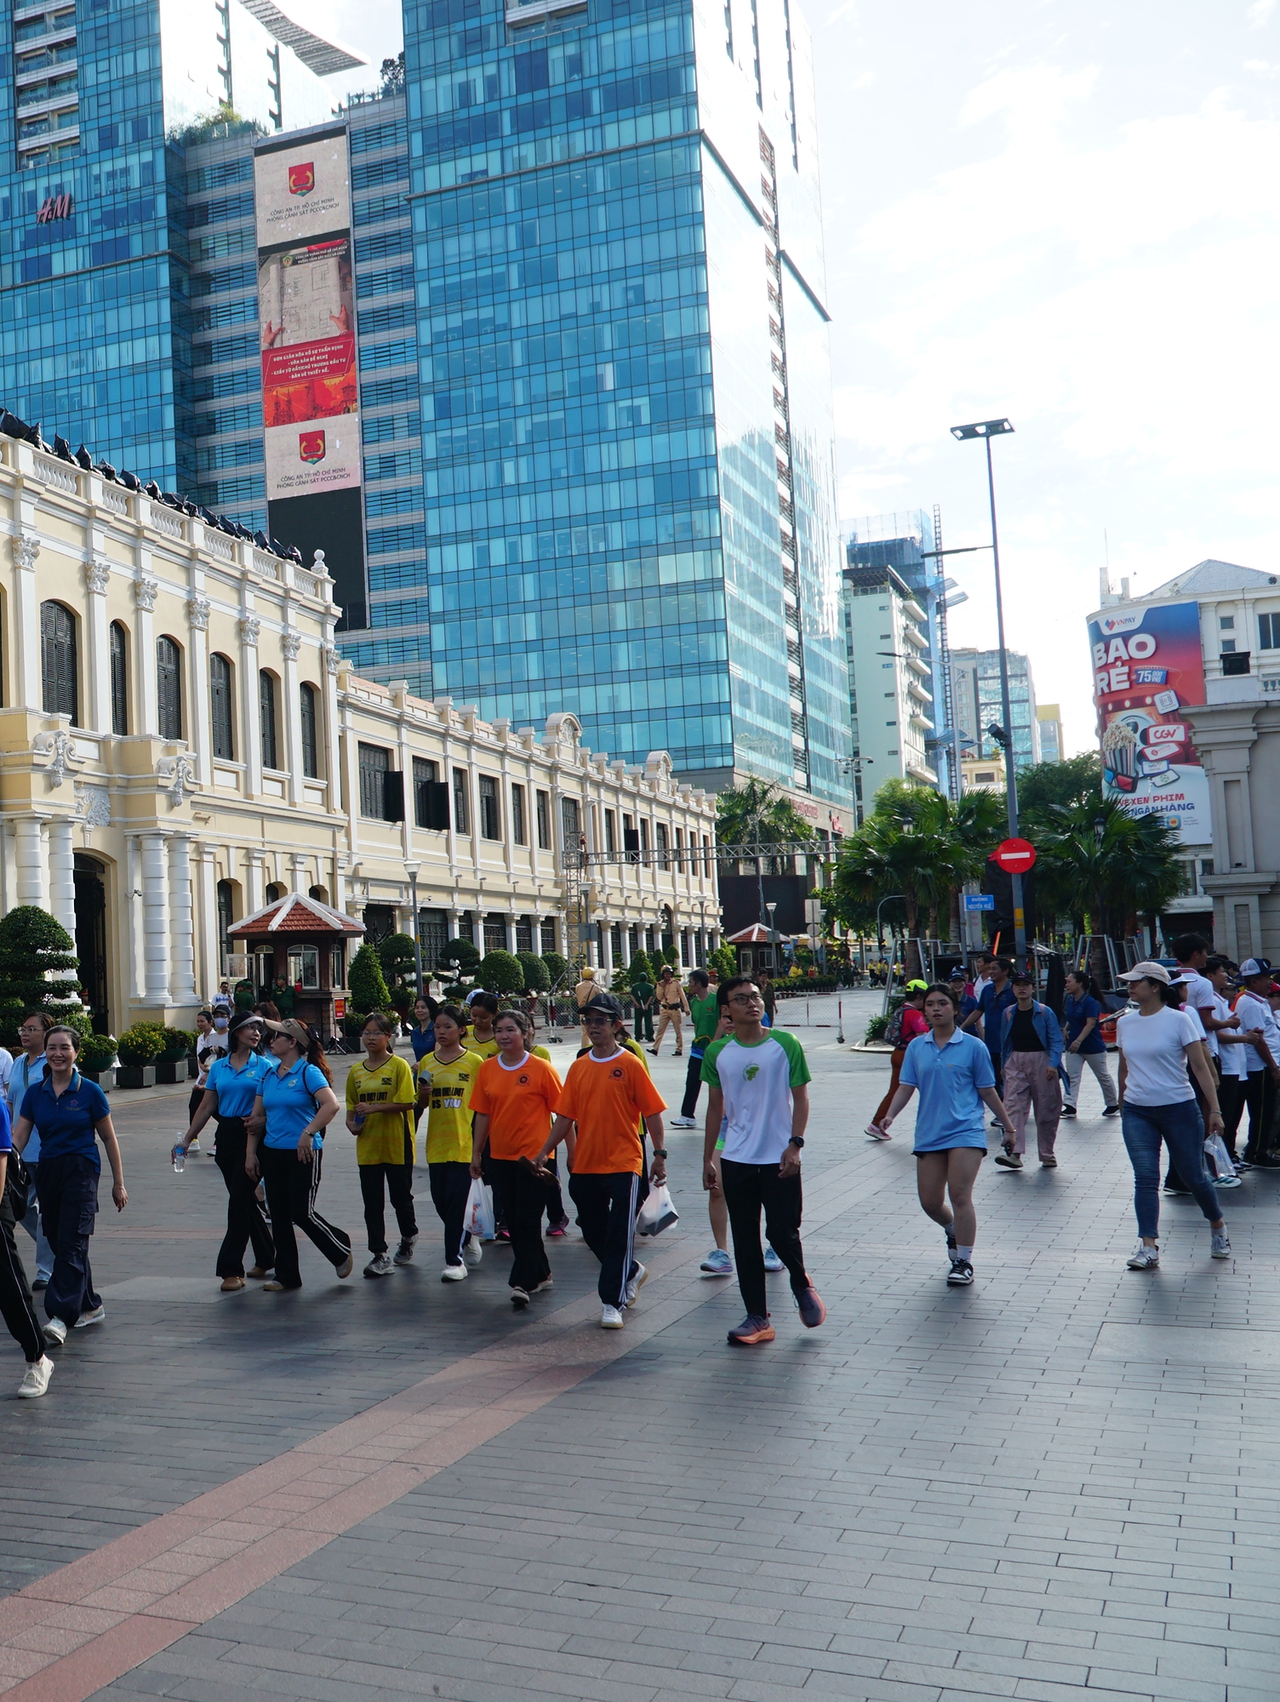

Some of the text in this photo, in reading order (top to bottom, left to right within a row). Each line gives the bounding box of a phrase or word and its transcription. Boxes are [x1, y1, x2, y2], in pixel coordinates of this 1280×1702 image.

[321, 197, 335, 205] MINH
[36, 192, 71, 224] H&M
[321, 468, 331, 476] CHÍ
[276, 481, 294, 489] PHÒNG
[309, 476, 319, 484] SÁT
[1116, 616, 1136, 626] VNPAY
[1092, 633, 1157, 669] BAO
[1095, 660, 1131, 697] RẺ
[1137, 670, 1151, 683] 75
[1153, 728, 1177, 739] CGV
[1152, 793, 1185, 803] PHIM
[1159, 802, 1195, 812] HÀNG
